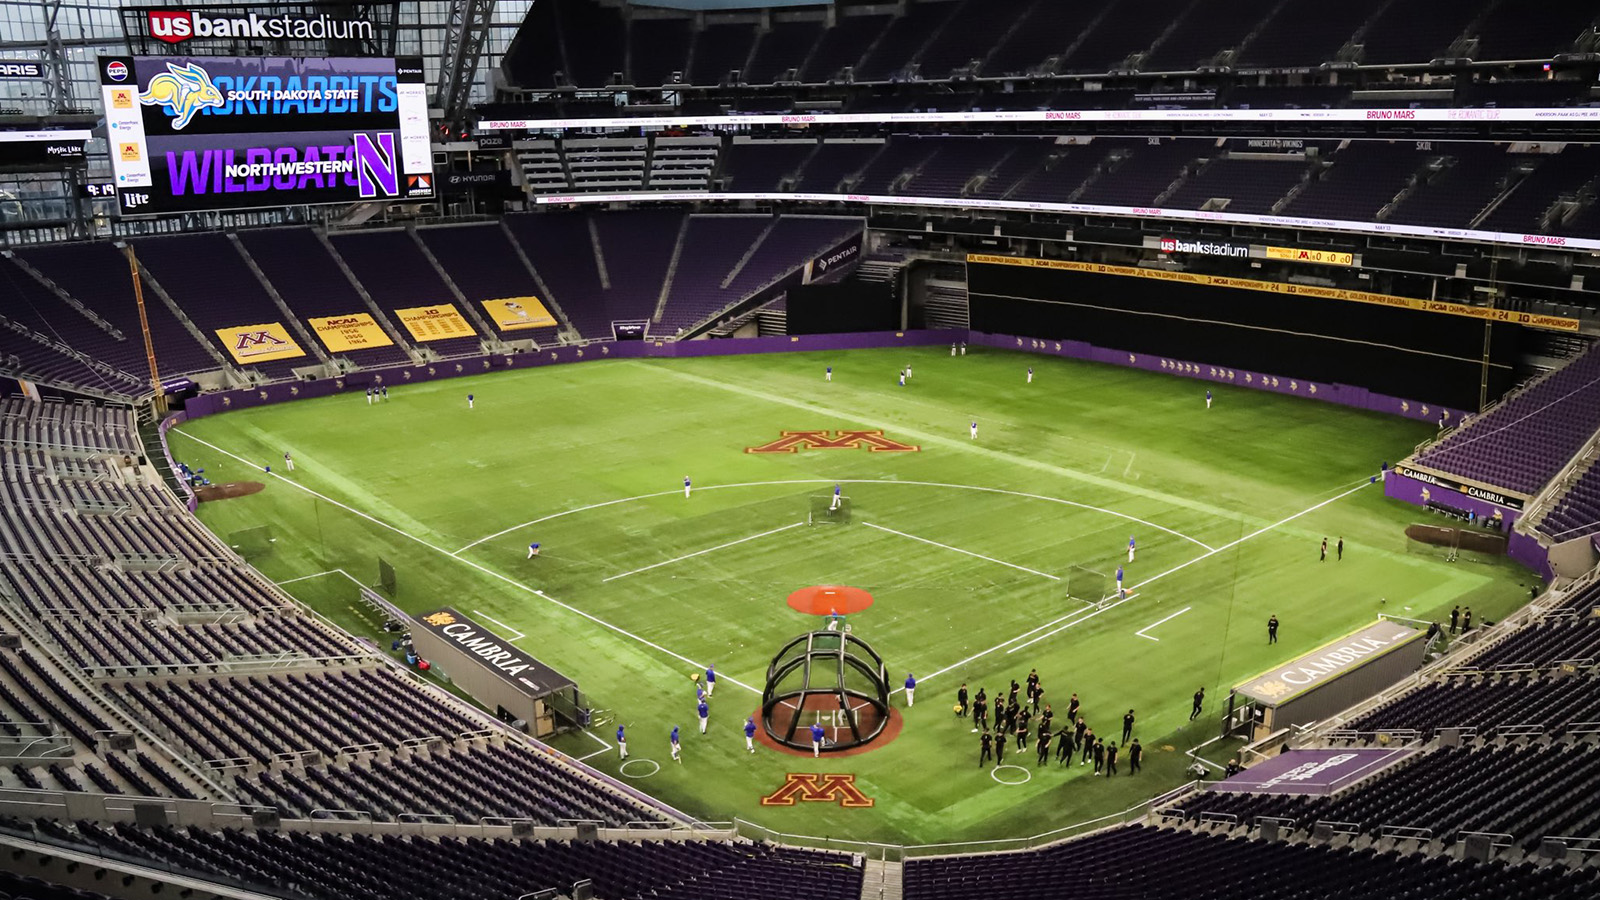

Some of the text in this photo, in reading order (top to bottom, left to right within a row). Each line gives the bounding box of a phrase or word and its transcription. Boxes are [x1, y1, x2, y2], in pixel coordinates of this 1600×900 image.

[227, 89, 358, 101] SOUTH DAKOTA STATE
[1367, 111, 1416, 119] BRUNO MARS
[1248, 140, 1304, 148] MINNESOTA VIKINGS
[1416, 141, 1431, 150] SKOL
[225, 160, 353, 178] NORTHWESTERN
[354, 132, 399, 198] N
[463, 174, 495, 182] HYUNDAI
[124, 193, 149, 208] Lite
[1523, 235, 1566, 245] BRUNO MARS
[827, 246, 858, 266] PENTAIR
[1050, 261, 1080, 269] CHAMPIONSHIPS
[1208, 276, 1212, 284] 3
[1229, 280, 1263, 290] CHAMPIONSHIPS
[1271, 283, 1279, 292] 24
[1298, 287, 1335, 298] CHAMPIONSHIPS
[1349, 291, 1367, 301] GOLDEN
[1368, 294, 1386, 304] GOPHER
[1387, 296, 1410, 307] BASEBALL
[1422, 301, 1427, 310] 3
[1428, 302, 1447, 312] NCAA
[1498, 310, 1508, 320] 24
[1531, 314, 1578, 329] CHAMPIONSHIPS
[327, 318, 359, 326] NCAA
[403, 312, 459, 322] CHAMPIONSHIPS
[316, 321, 374, 332] CHAMPIONSHIPS
[1403, 468, 1436, 485] CAMBRIA
[1468, 483, 1505, 505] CAMBRIA
[442, 623, 532, 677] CAMBRIA
[1280, 635, 1390, 685] CAMBRIA
